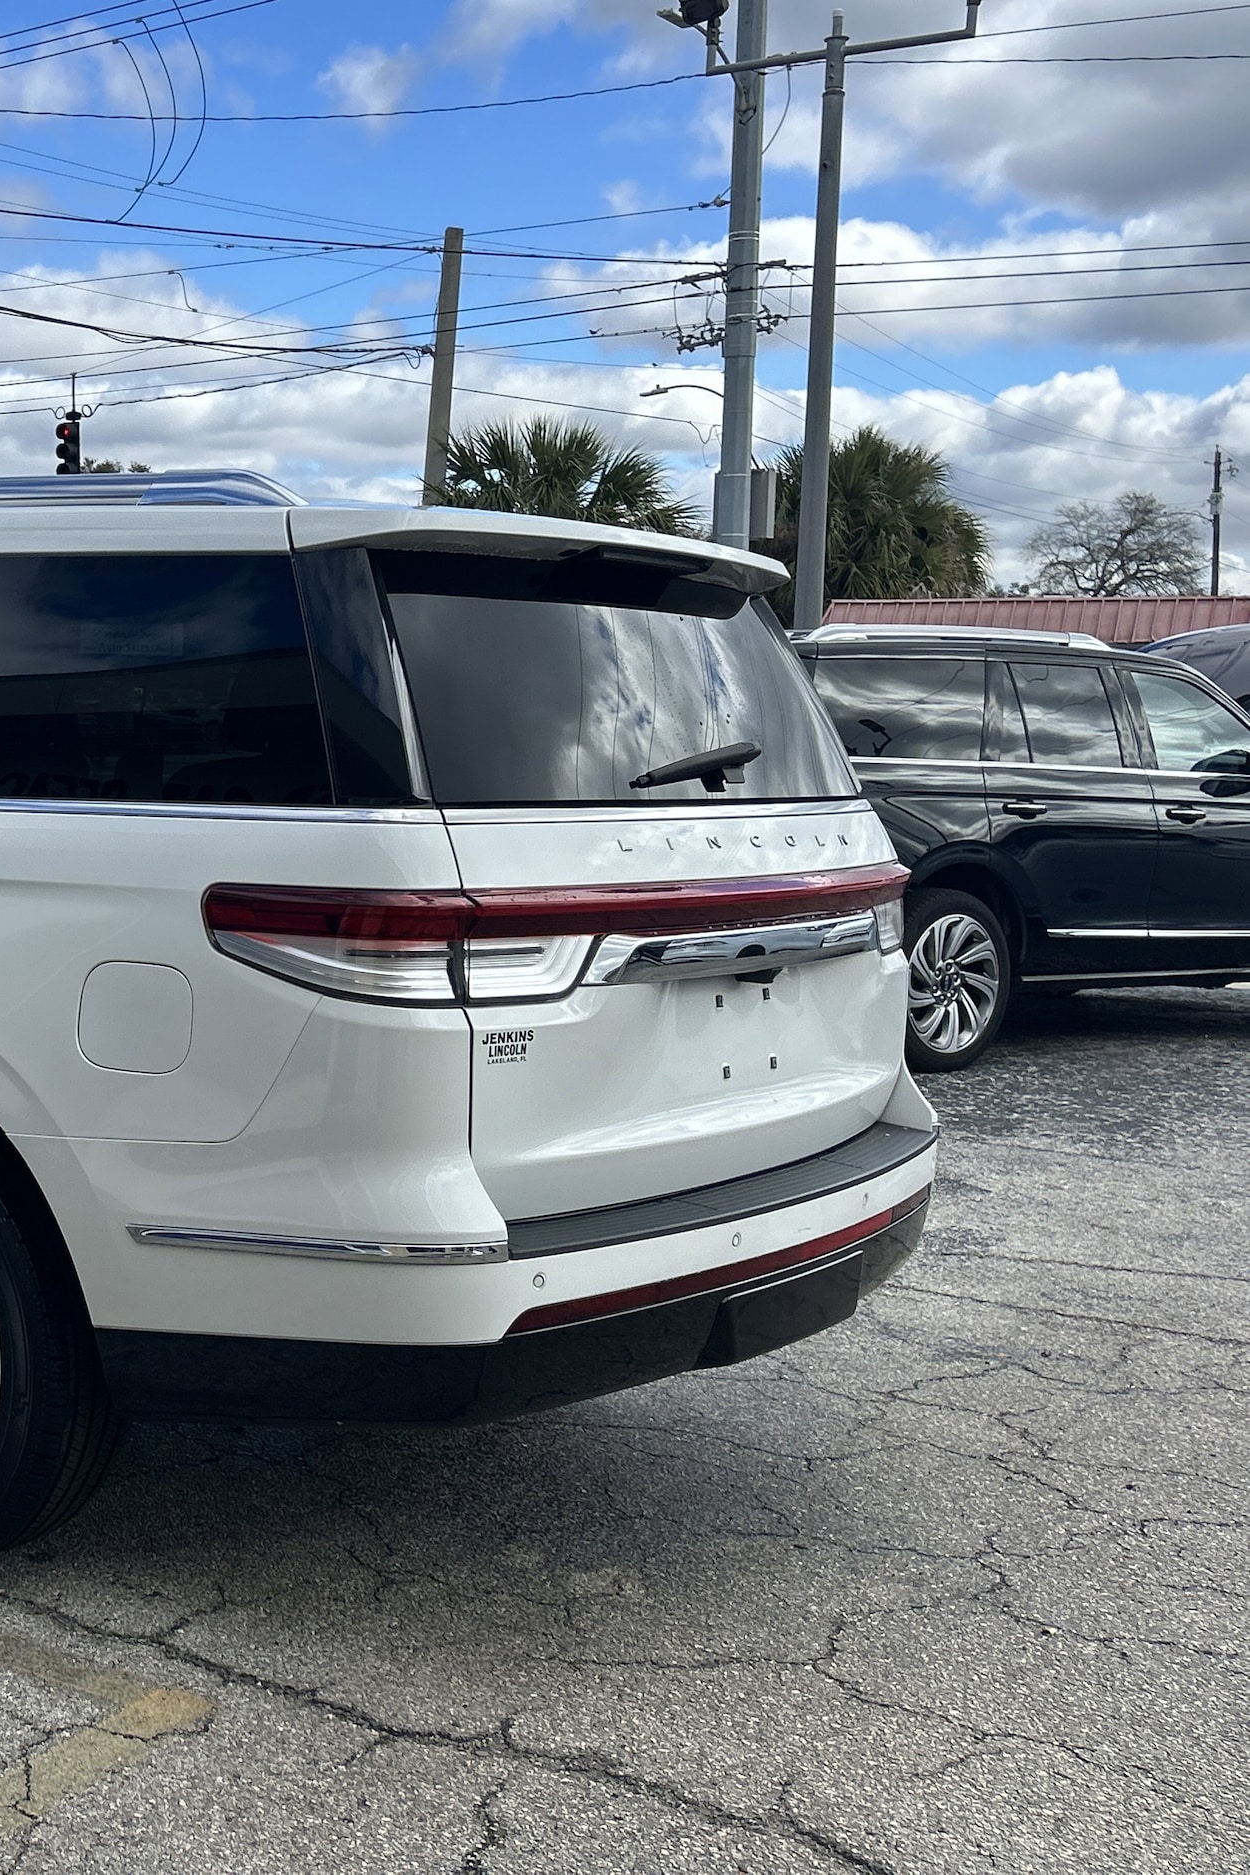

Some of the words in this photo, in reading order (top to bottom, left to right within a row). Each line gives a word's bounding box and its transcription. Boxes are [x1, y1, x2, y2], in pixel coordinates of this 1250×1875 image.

[616, 835, 849, 852] LINCOLN
[482, 1030, 534, 1045] JENKINS
[488, 1043, 527, 1057] LINCOLN
